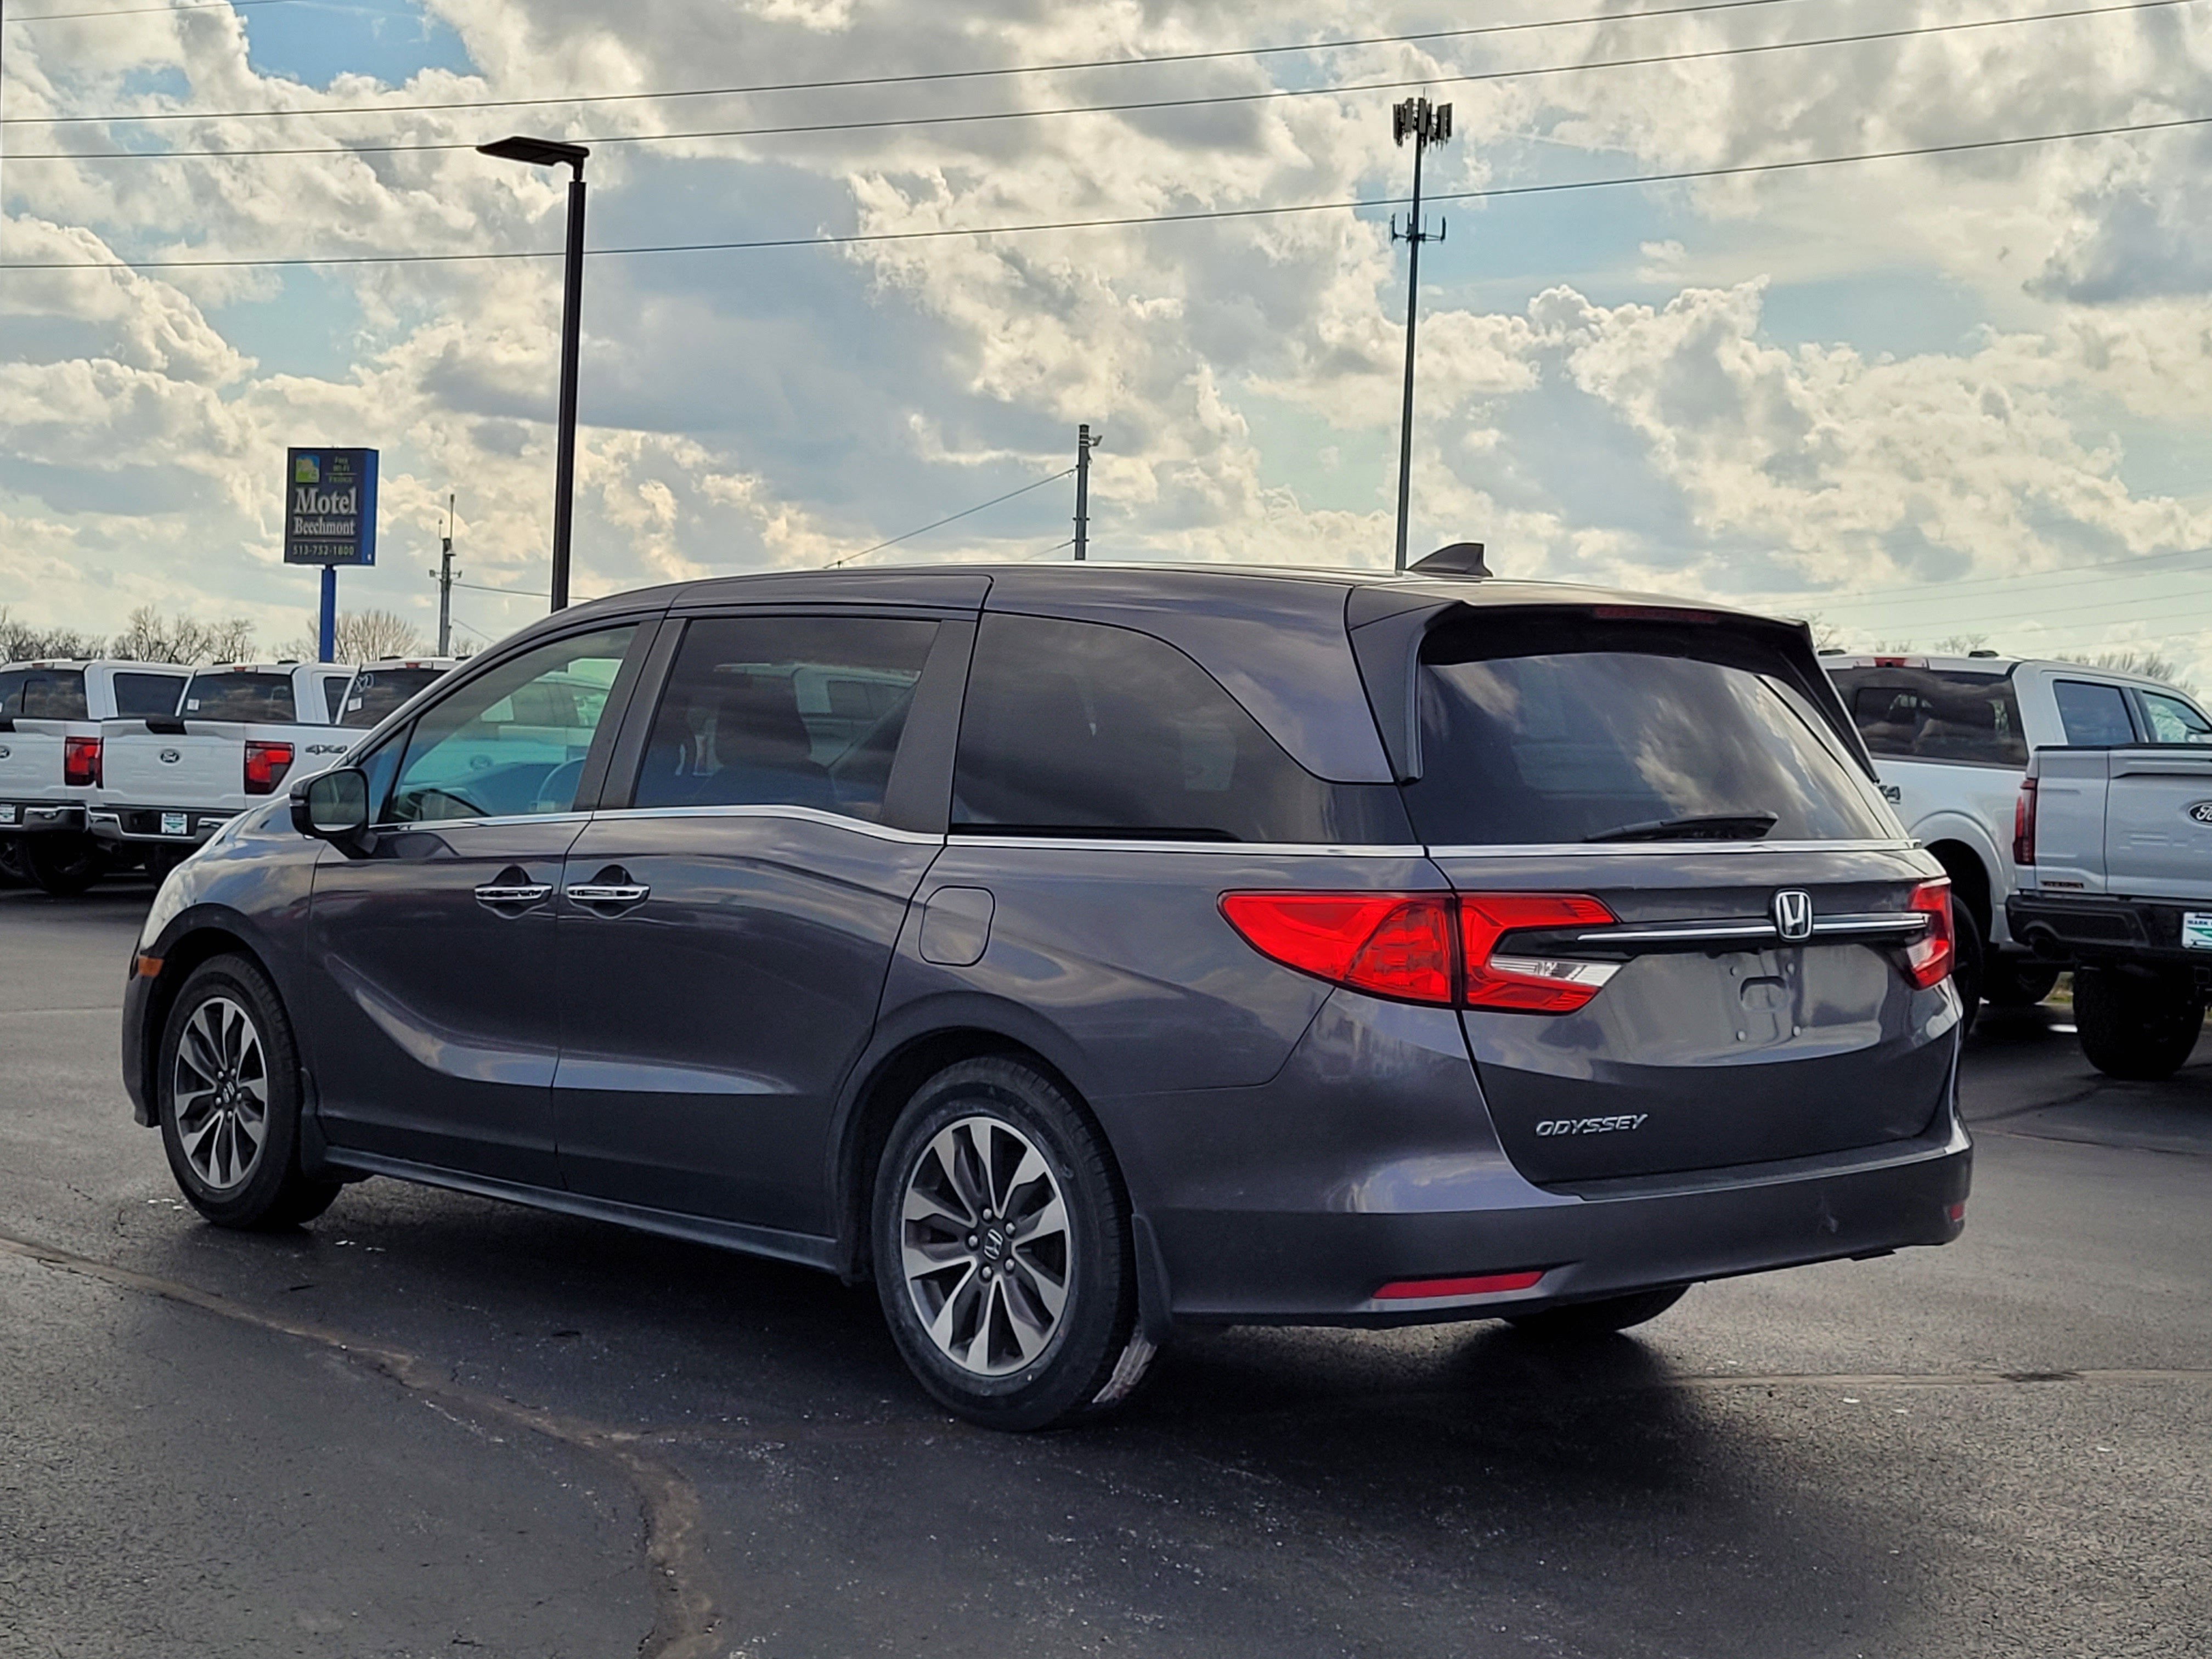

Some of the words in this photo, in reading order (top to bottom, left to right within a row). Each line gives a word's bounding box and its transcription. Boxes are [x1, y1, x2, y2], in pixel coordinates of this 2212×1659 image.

[293, 486, 357, 515] Motel
[293, 516, 356, 535] Beechmont
[1536, 1113, 1649, 1136] ODYSSEY
